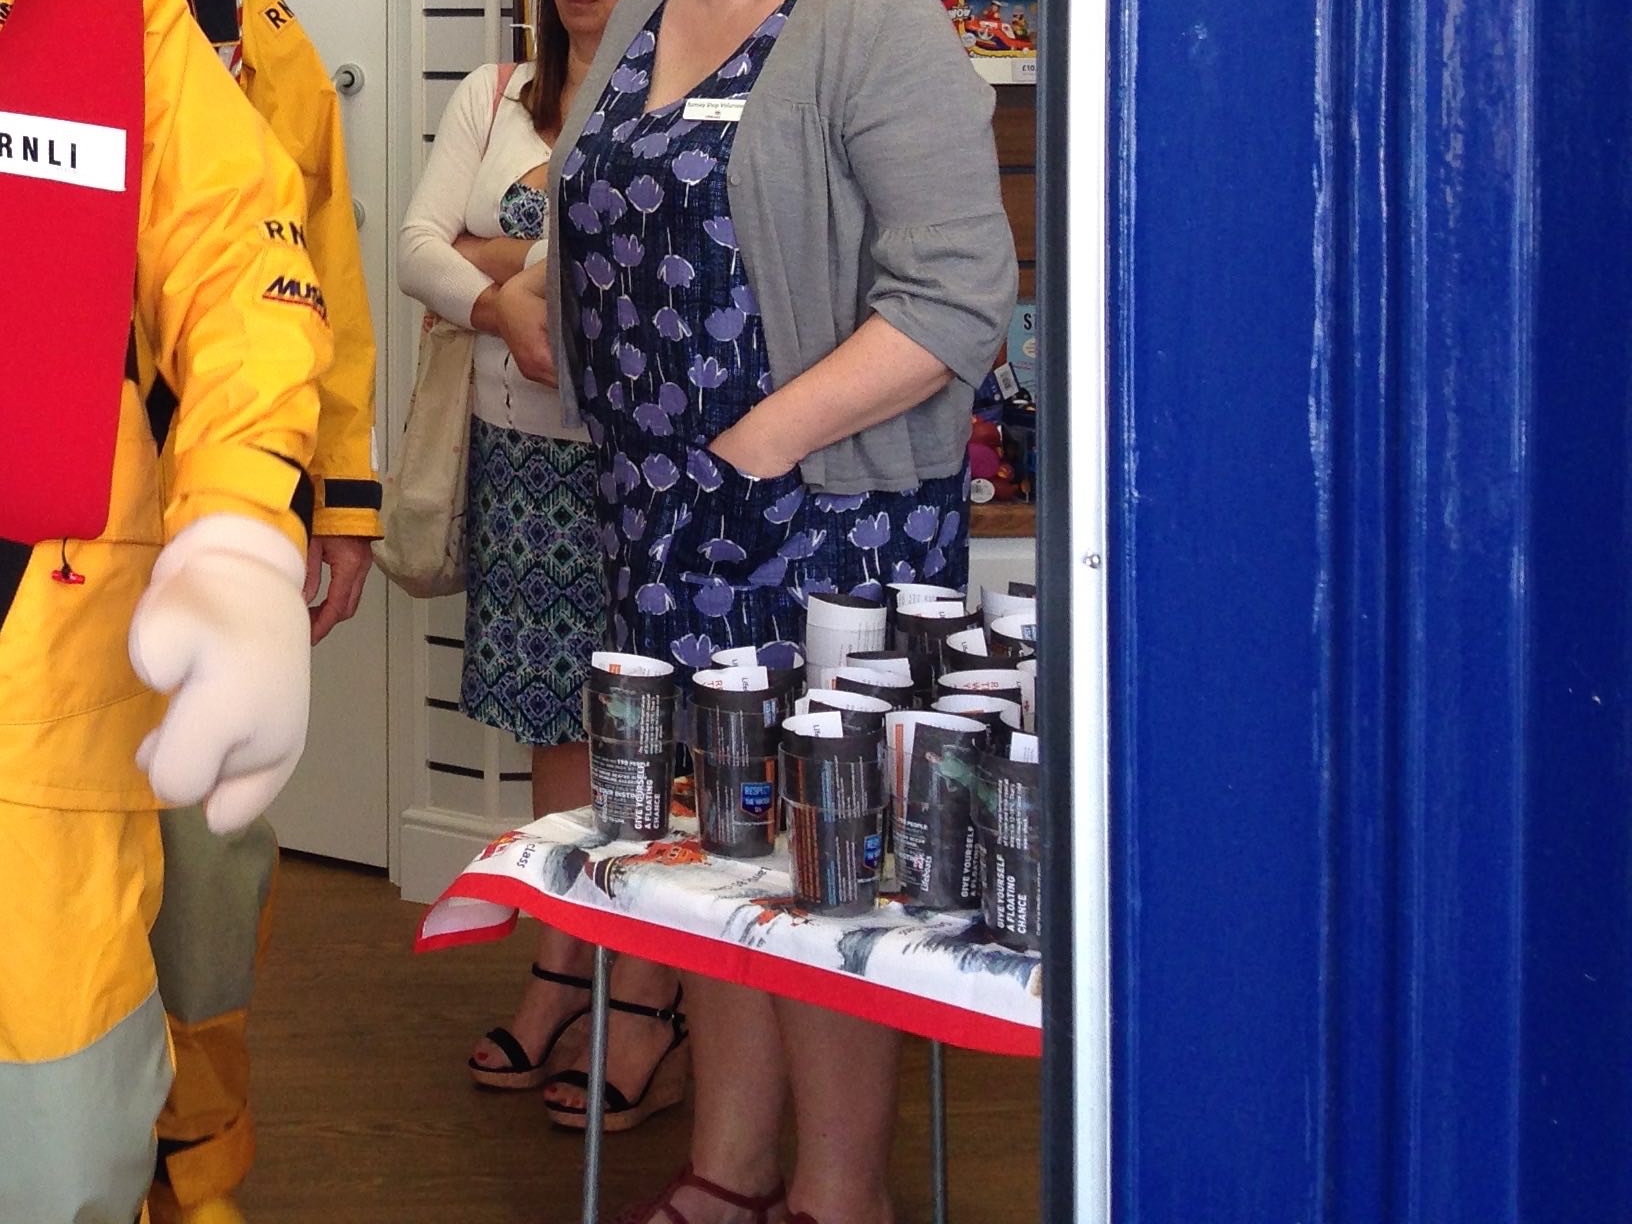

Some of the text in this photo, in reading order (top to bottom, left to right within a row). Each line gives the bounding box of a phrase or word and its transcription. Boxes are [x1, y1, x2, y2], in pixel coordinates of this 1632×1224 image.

[634, 808, 643, 830] GIVE
[920, 855, 932, 892] Lifeboats
[961, 875, 970, 898] GIVE
[996, 853, 1006, 929] GIVE YOURSELF
[1006, 875, 1016, 932] A FLOATING
[1017, 893, 1027, 935] CHANCE
